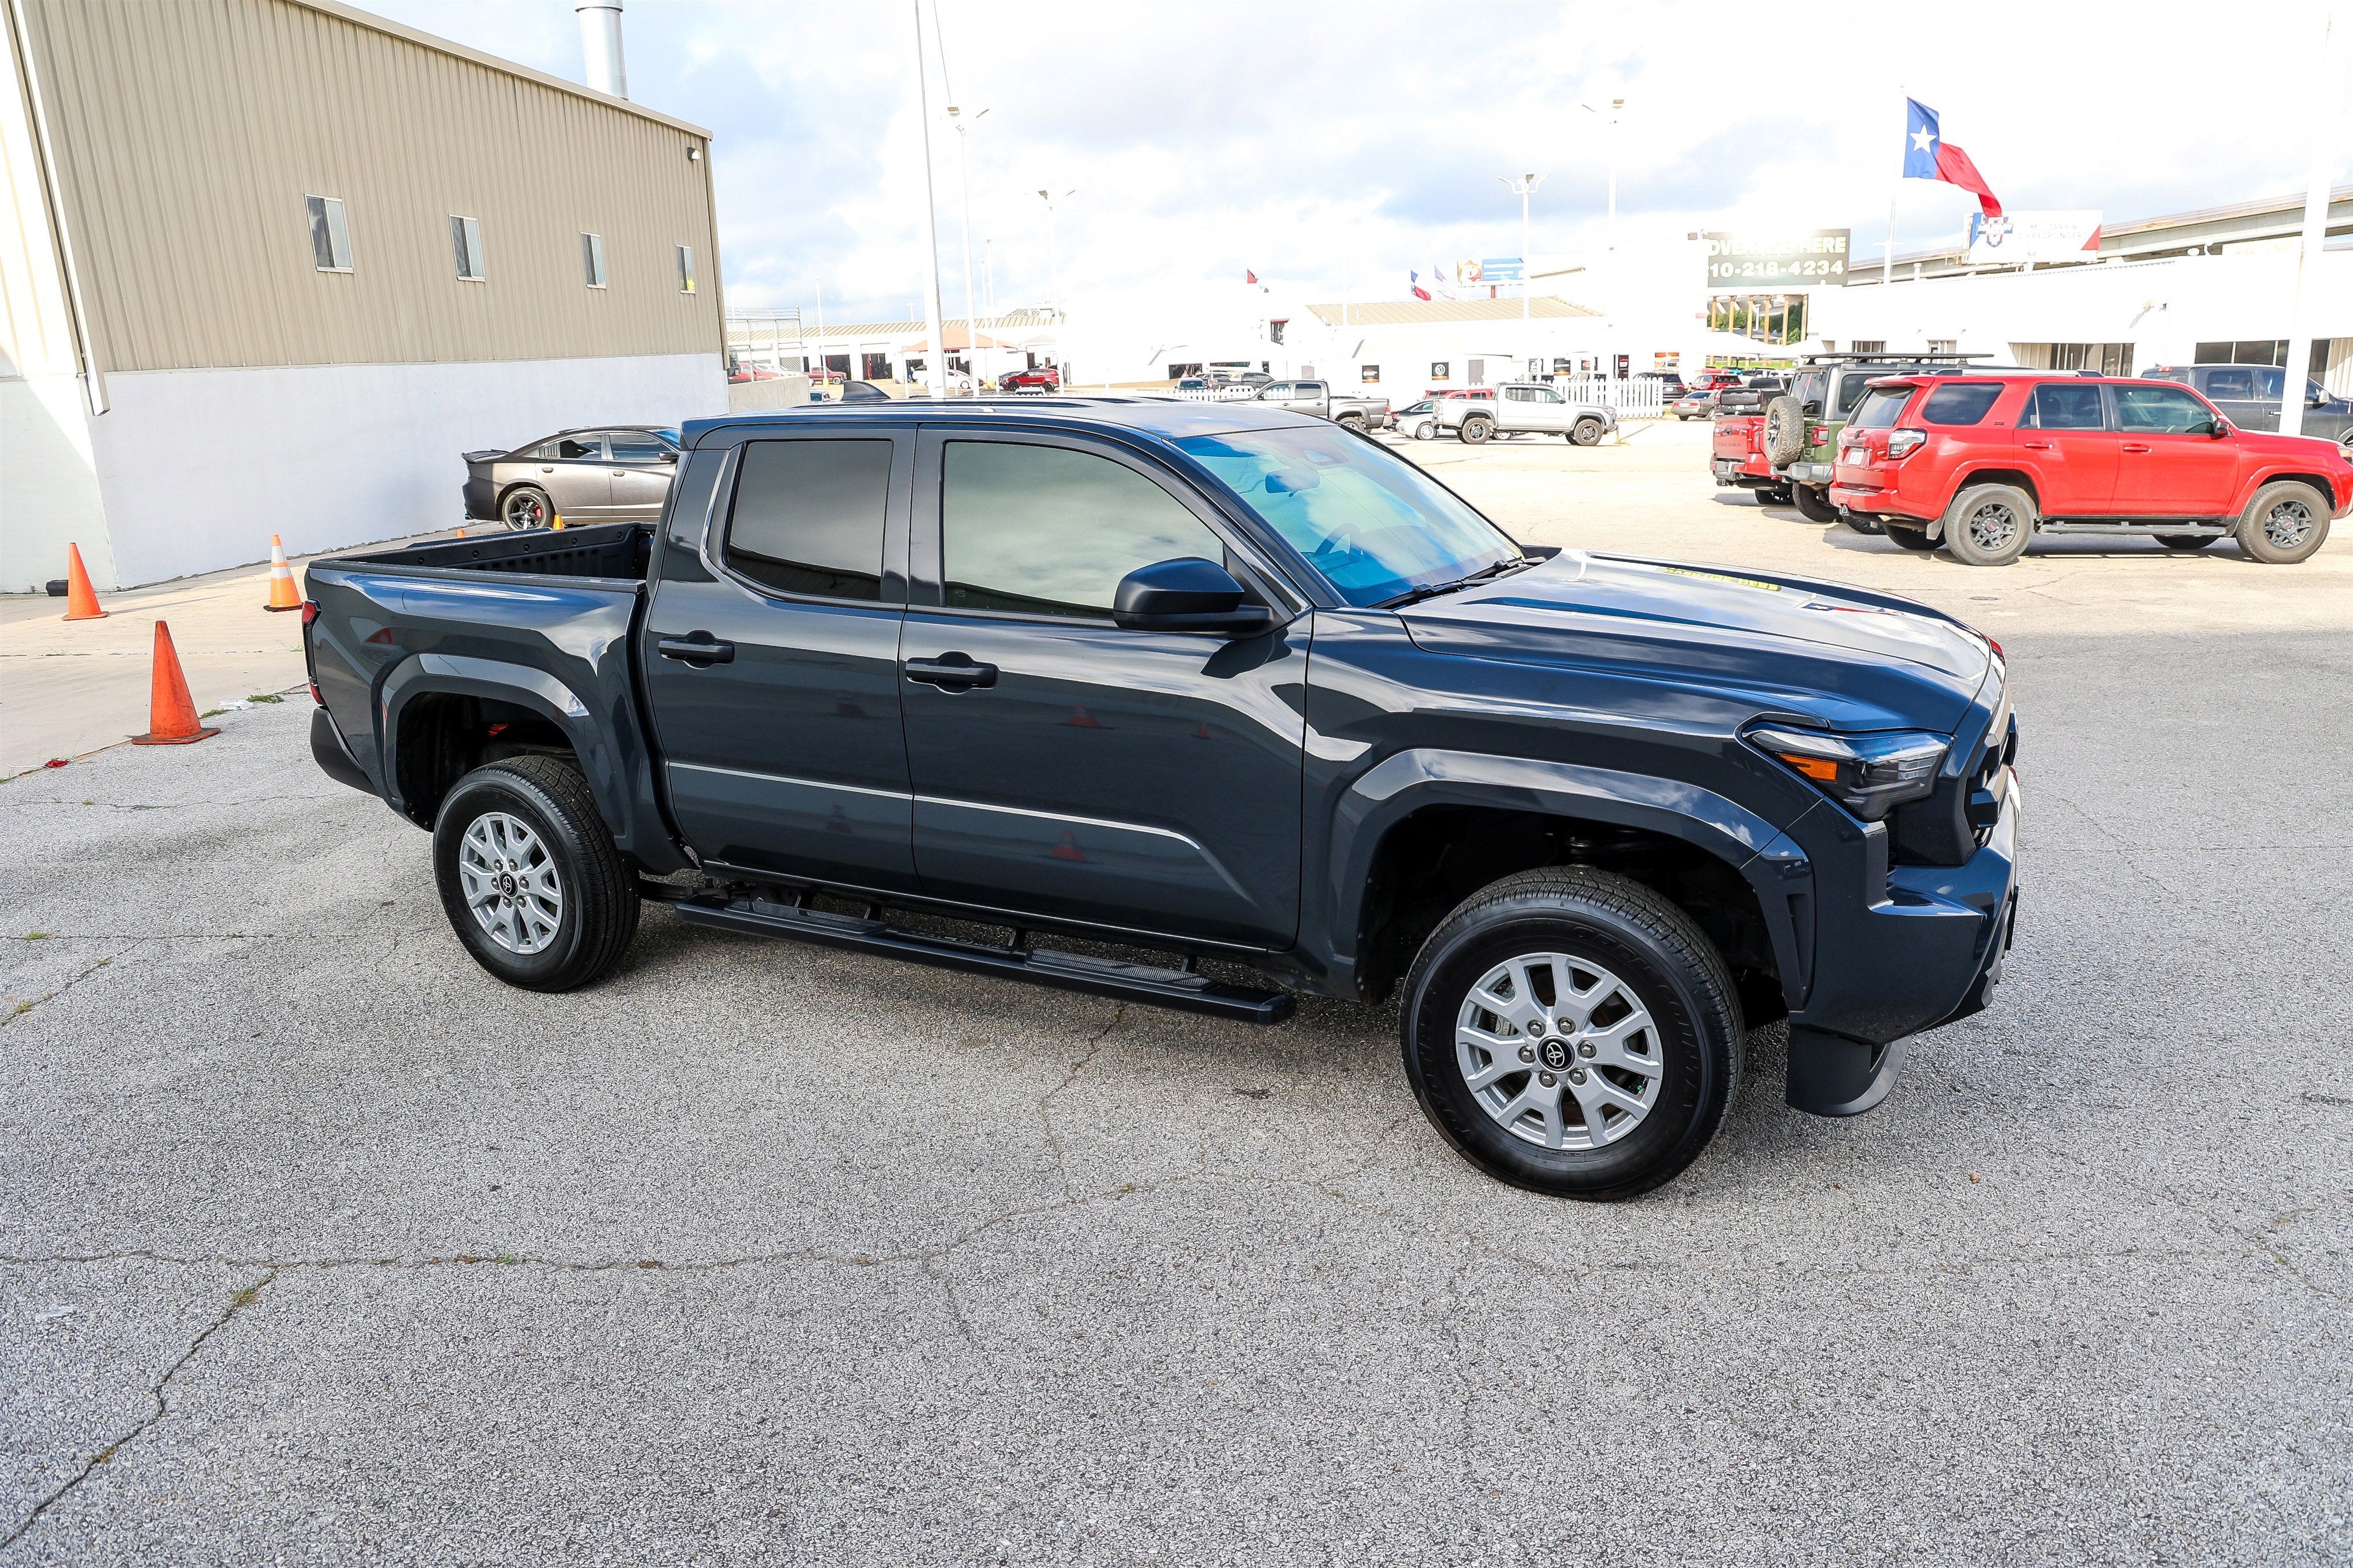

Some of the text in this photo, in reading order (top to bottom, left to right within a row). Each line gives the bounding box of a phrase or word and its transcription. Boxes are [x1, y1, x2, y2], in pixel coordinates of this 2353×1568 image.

[1708, 237, 1846, 256] DVERTISE HERE
[1708, 260, 1844, 278] 10-218-4234
